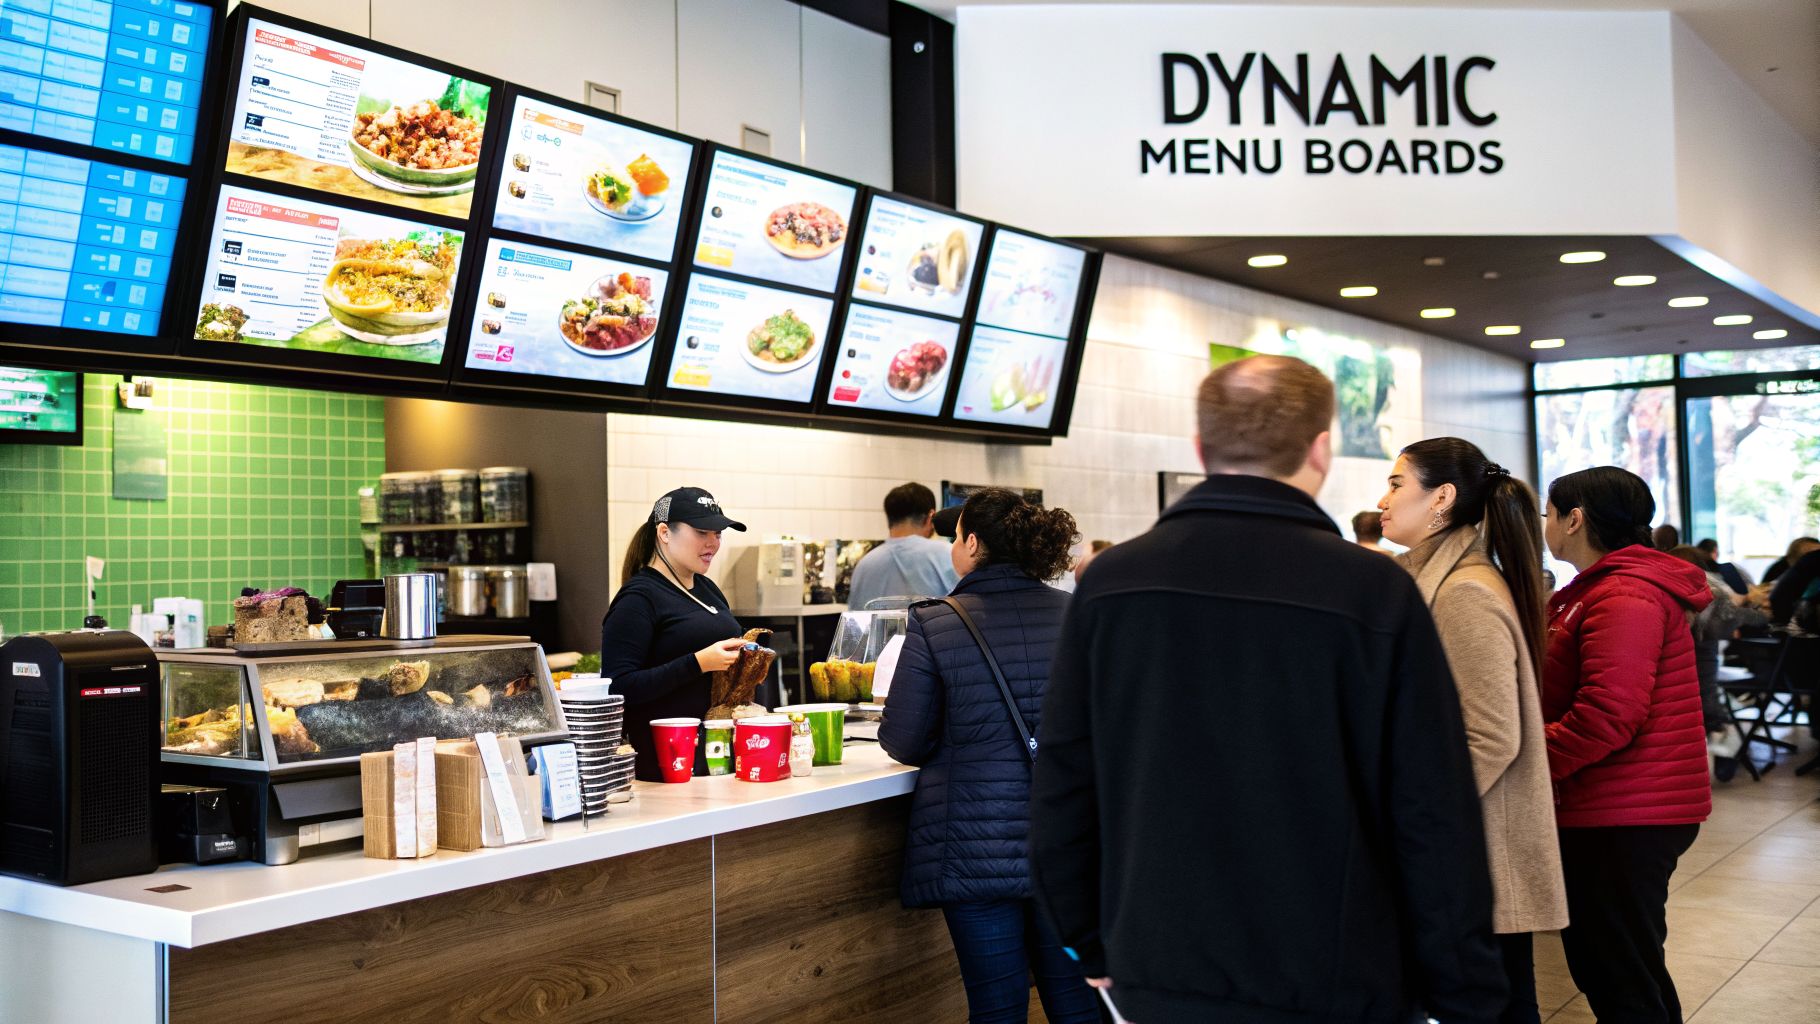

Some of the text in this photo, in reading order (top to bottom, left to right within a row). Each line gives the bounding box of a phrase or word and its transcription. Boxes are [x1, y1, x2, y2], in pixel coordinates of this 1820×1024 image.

[1161, 52, 1498, 128] DYNAMIC
[1140, 138, 1504, 175] MENU BOARDS
